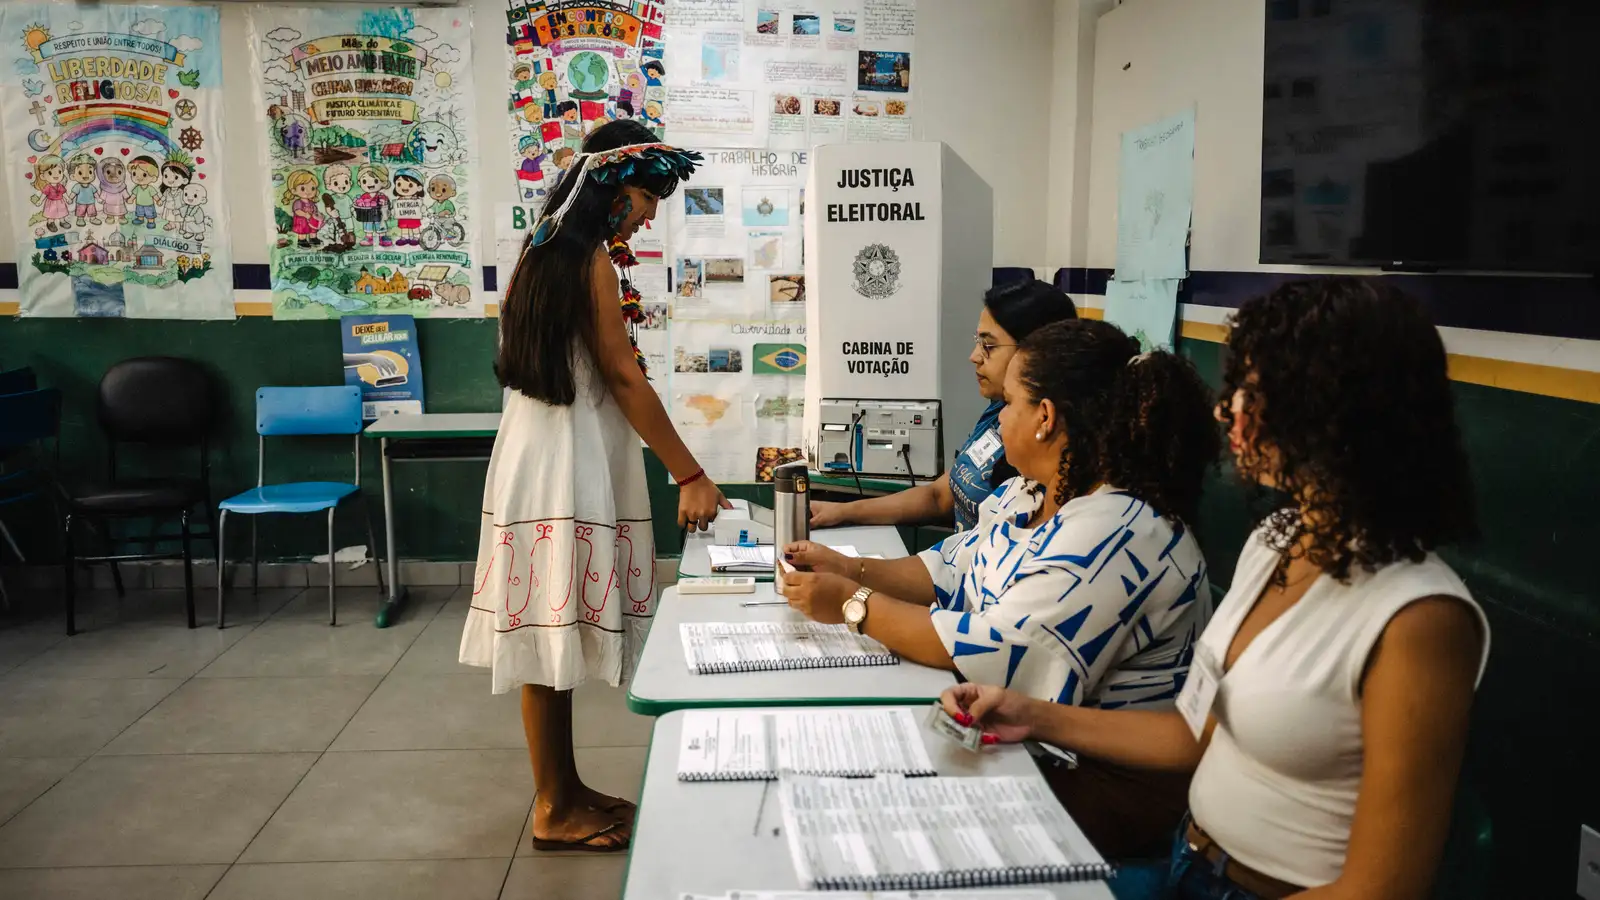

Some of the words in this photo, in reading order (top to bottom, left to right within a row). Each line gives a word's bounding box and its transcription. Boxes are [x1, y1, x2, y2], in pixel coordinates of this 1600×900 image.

[547, 9, 624, 27] ENCONTRO
[550, 24, 576, 39] DAS
[579, 23, 626, 40] NAÇÕES
[53, 39, 86, 51] RESPEITO
[87, 37, 91, 46] E
[92, 35, 112, 46] UNIÃO
[114, 37, 135, 48] ENTRE
[135, 40, 162, 53] TODOS!
[366, 38, 378, 48] do
[47, 56, 168, 85] LIBERDADE
[306, 54, 343, 76] MEIO
[347, 53, 416, 76] AMBIENTE
[55, 79, 162, 106] RELIGIOSA
[326, 100, 356, 110] JUSTIÇA
[358, 98, 396, 108] CLIMÁTICA
[326, 109, 355, 117] FUTURO
[357, 108, 402, 117] SUSTENTÁVEL
[708, 152, 777, 165] TRABALHO
[792, 152, 807, 164] DE
[751, 163, 798, 176] HISTÓRIA
[837, 167, 915, 192] JUSTIÇA
[396, 201, 420, 209] ENERGIA
[827, 202, 925, 222] ELEITORAL
[355, 325, 375, 335] DEIXE
[362, 332, 393, 344] CELULAR
[842, 341, 892, 355] CABINA
[896, 341, 914, 355] DE
[847, 357, 910, 378] VOTAÇÃO
